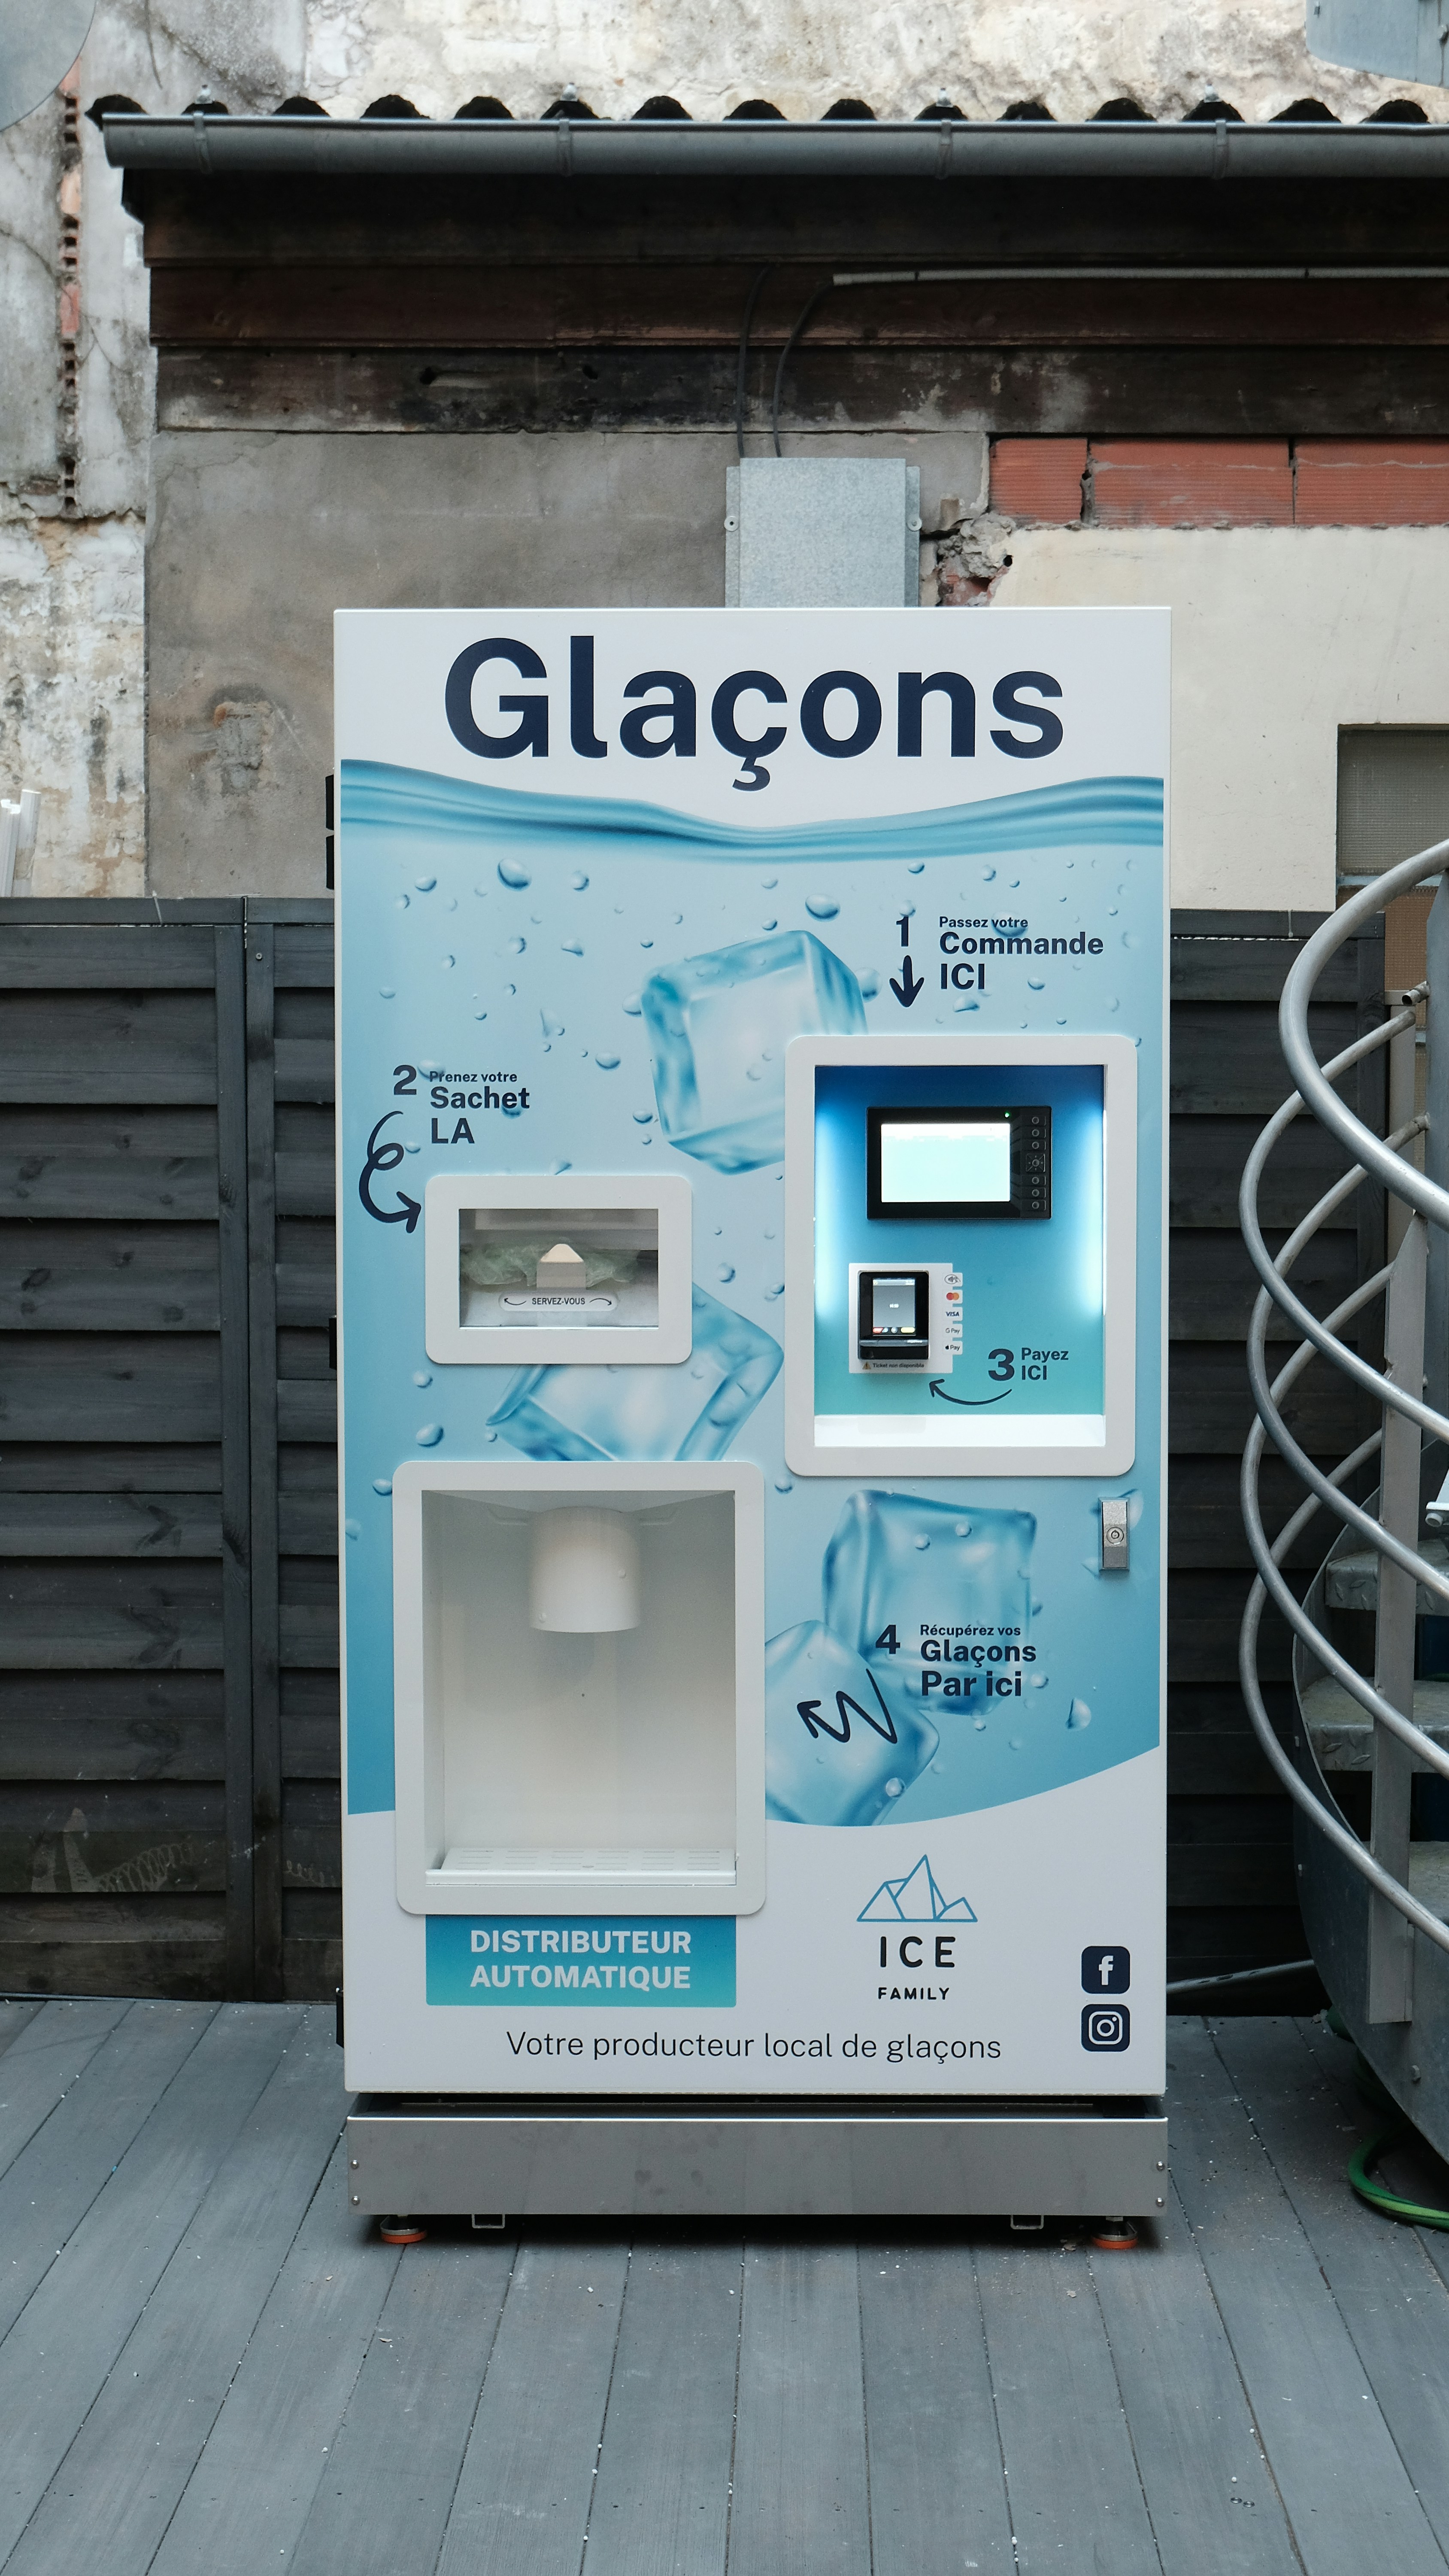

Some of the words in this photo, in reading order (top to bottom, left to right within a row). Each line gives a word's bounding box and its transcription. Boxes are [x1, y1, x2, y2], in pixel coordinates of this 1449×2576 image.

[445, 635, 1063, 791] Glaçons
[896, 916, 909, 947] 1
[939, 916, 988, 928] Passez
[991, 917, 1028, 928] votre
[939, 931, 1104, 955] Commande
[941, 963, 985, 990] ICI
[393, 1064, 417, 1095] 2
[429, 1071, 478, 1082] Prenez
[481, 1072, 517, 1082] votre
[430, 1086, 530, 1109] Sachet
[431, 1118, 475, 1144] LA
[988, 1348, 1015, 1381] 3
[1022, 1347, 1069, 1363] Payez
[1022, 1365, 1047, 1380] ICI
[875, 1624, 901, 1655] 4
[920, 1624, 994, 1638] Récupérez
[997, 1627, 1021, 1636] vos
[921, 1639, 1036, 1668] Glaçons
[921, 1671, 977, 1697] Par
[986, 1671, 1022, 1697] ici
[471, 1930, 691, 1953] DISTRIBUTEUR
[880, 1936, 956, 1968] ICE
[470, 1965, 690, 1992] AUTOMATIQUE
[878, 1987, 949, 2000] FAMILY
[506, 2031, 583, 2055] Votre
[594, 2032, 754, 2060] producteur
[765, 2032, 832, 2057] local
[842, 2033, 876, 2057] de
[887, 2034, 1000, 2064] glaçons
